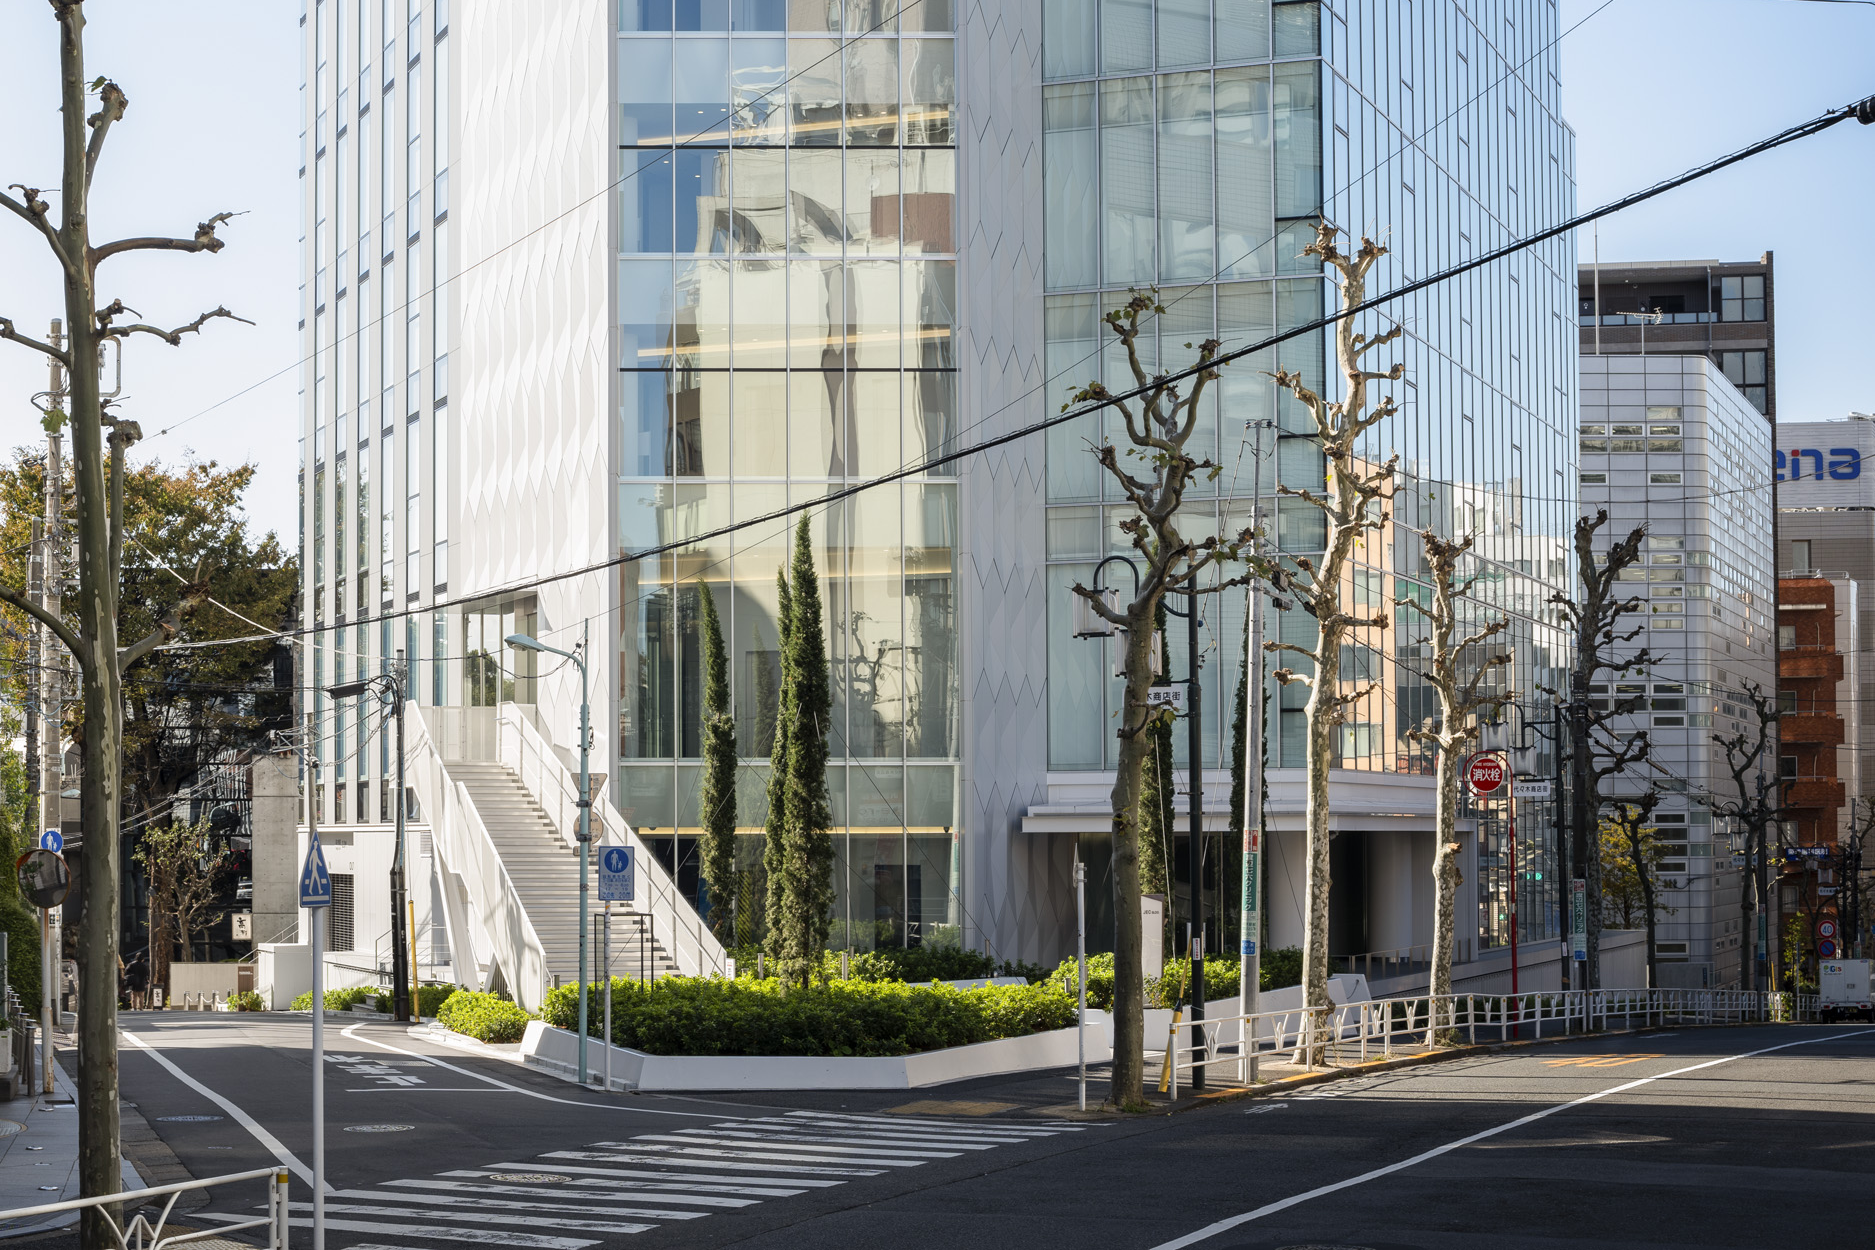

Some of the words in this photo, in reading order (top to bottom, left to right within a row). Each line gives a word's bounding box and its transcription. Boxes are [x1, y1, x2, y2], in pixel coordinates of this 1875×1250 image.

[1473, 768, 1500, 781] 消火栓
[1822, 925, 1833, 934] 40
